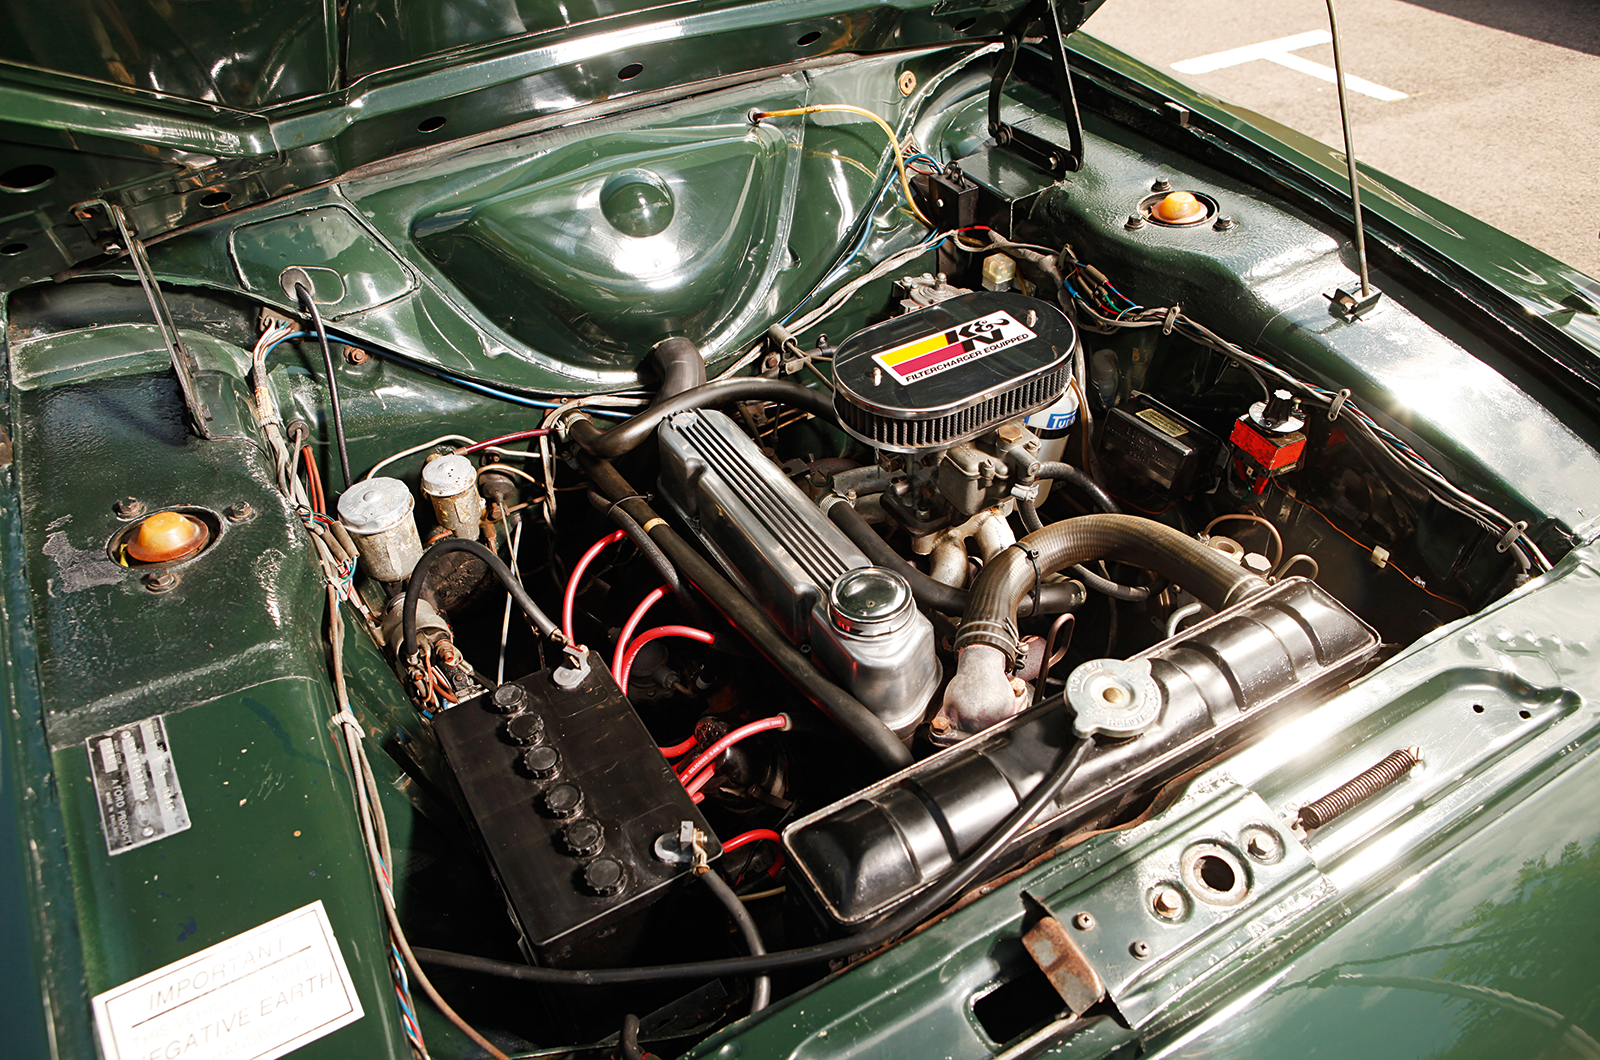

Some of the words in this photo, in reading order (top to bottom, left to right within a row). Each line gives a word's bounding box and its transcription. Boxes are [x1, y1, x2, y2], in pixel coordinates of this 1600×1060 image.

[945, 318, 1010, 353] K&N
[905, 350, 983, 383] FILTERCHARGER
[984, 333, 1029, 354] EQUIPPED
[1069, 662, 1104, 693] TIGHTEN
[1107, 710, 1152, 727] REMOVE
[688, 755, 709, 774] SILICONE
[113, 785, 126, 808] FORD
[118, 811, 133, 846] PRODUCT
[149, 935, 286, 1011] IMPORTANT
[261, 968, 333, 1017] EARTH
[132, 1023, 170, 1048] THIS
[175, 990, 240, 1028] VEHICLE
[248, 982, 262, 995] IS
[212, 1011, 304, 1060] HANDBOOK
